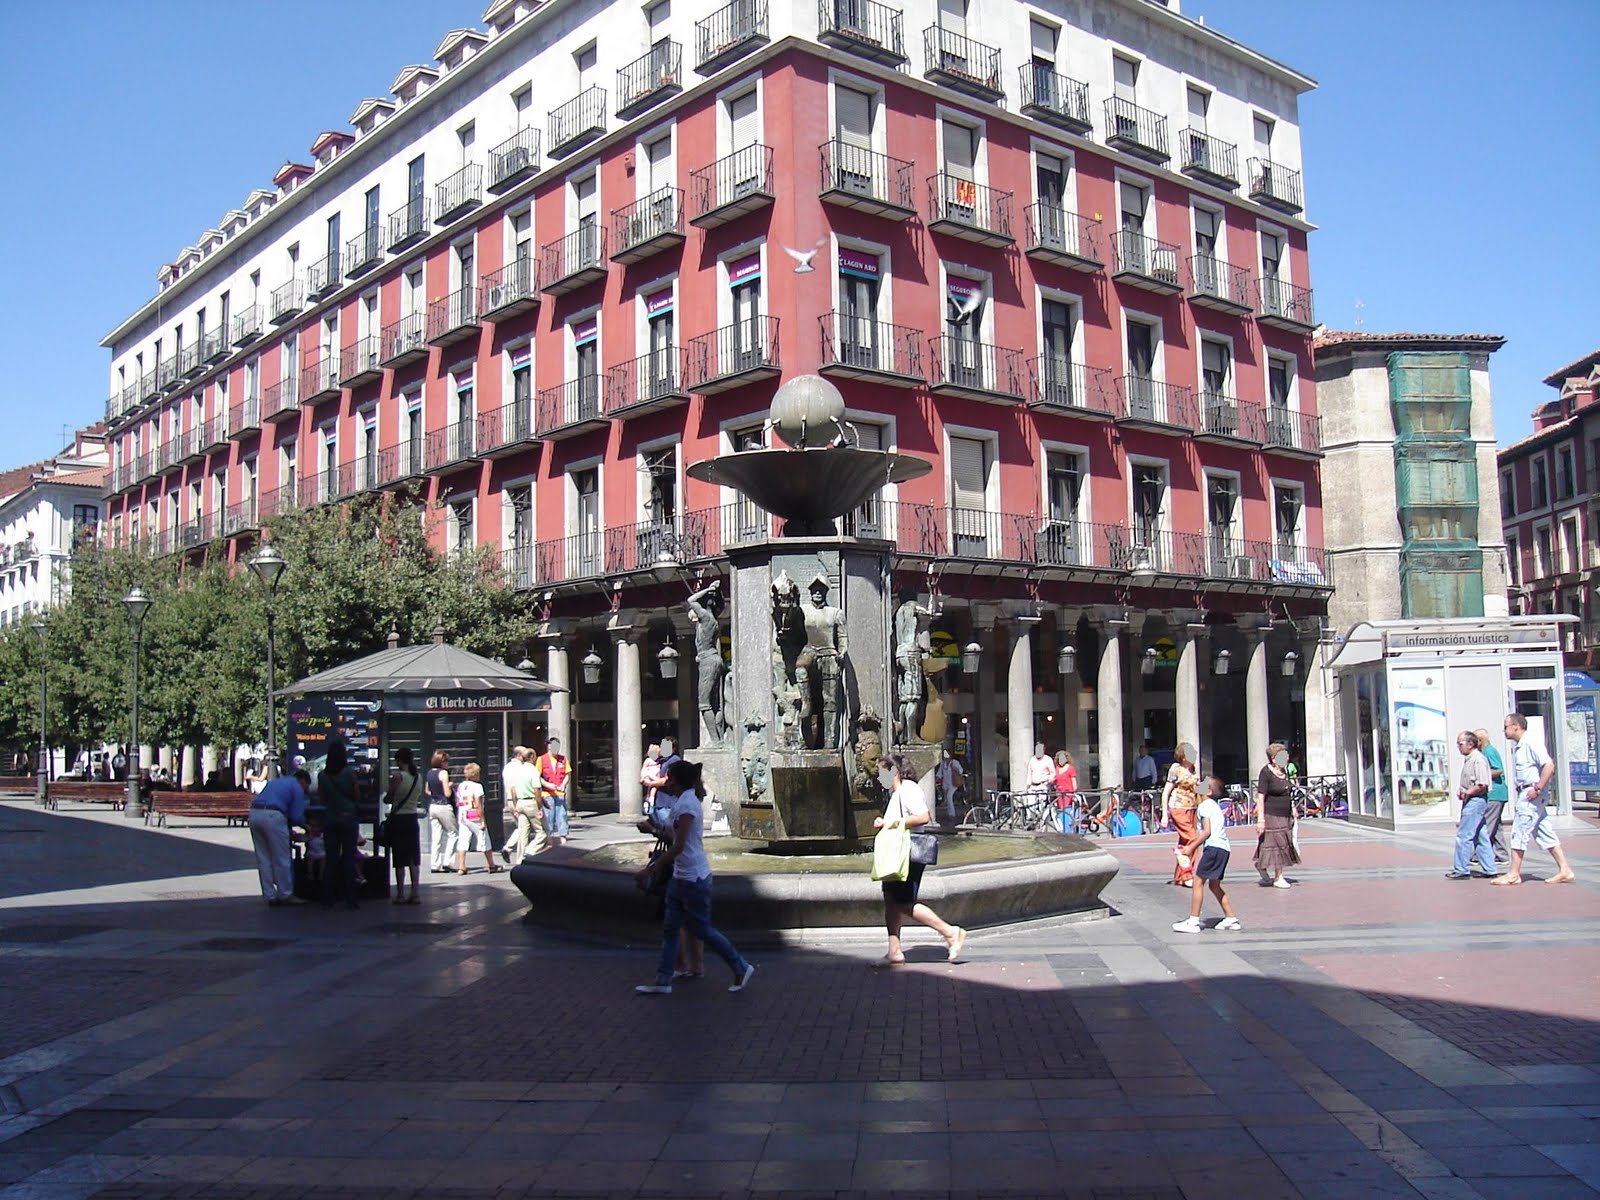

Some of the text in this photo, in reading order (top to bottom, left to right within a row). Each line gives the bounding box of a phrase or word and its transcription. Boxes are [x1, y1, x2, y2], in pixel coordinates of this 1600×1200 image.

[1405, 632, 1509, 646] información turística
[425, 696, 513, 709] El Norte de Castilla
